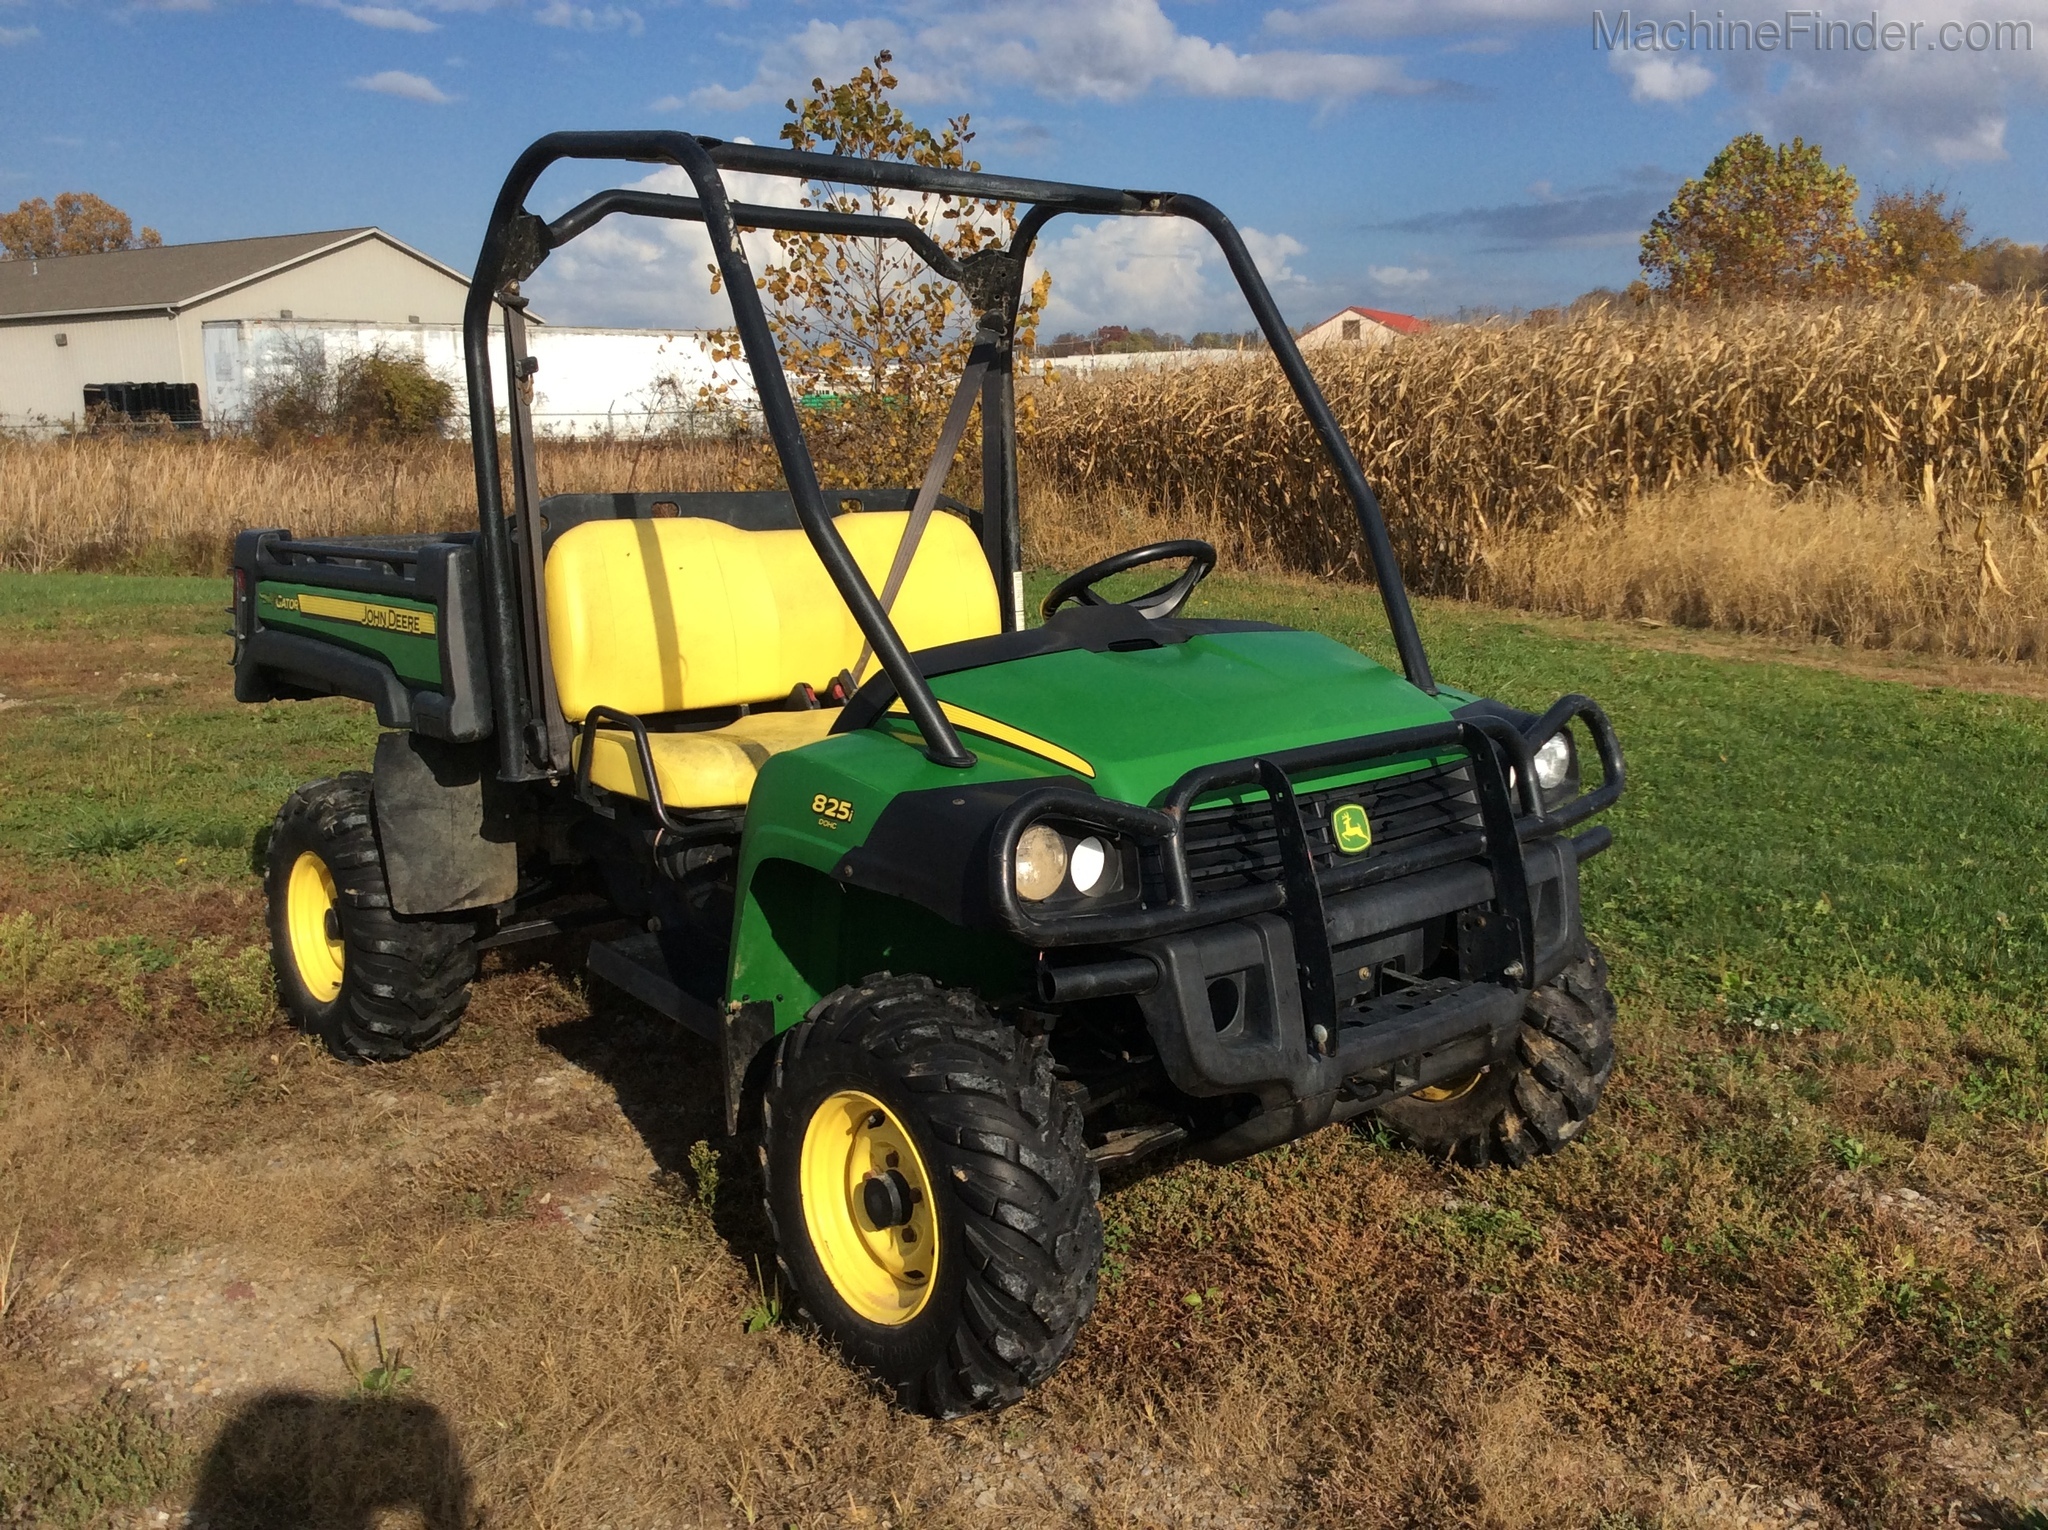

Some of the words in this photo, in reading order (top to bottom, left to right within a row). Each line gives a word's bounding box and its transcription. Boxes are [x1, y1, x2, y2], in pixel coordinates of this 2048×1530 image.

[276, 595, 299, 610] GATOR
[361, 606, 387, 627] JOHN
[388, 609, 420, 633] DEERE
[818, 818, 838, 830] DOHC
